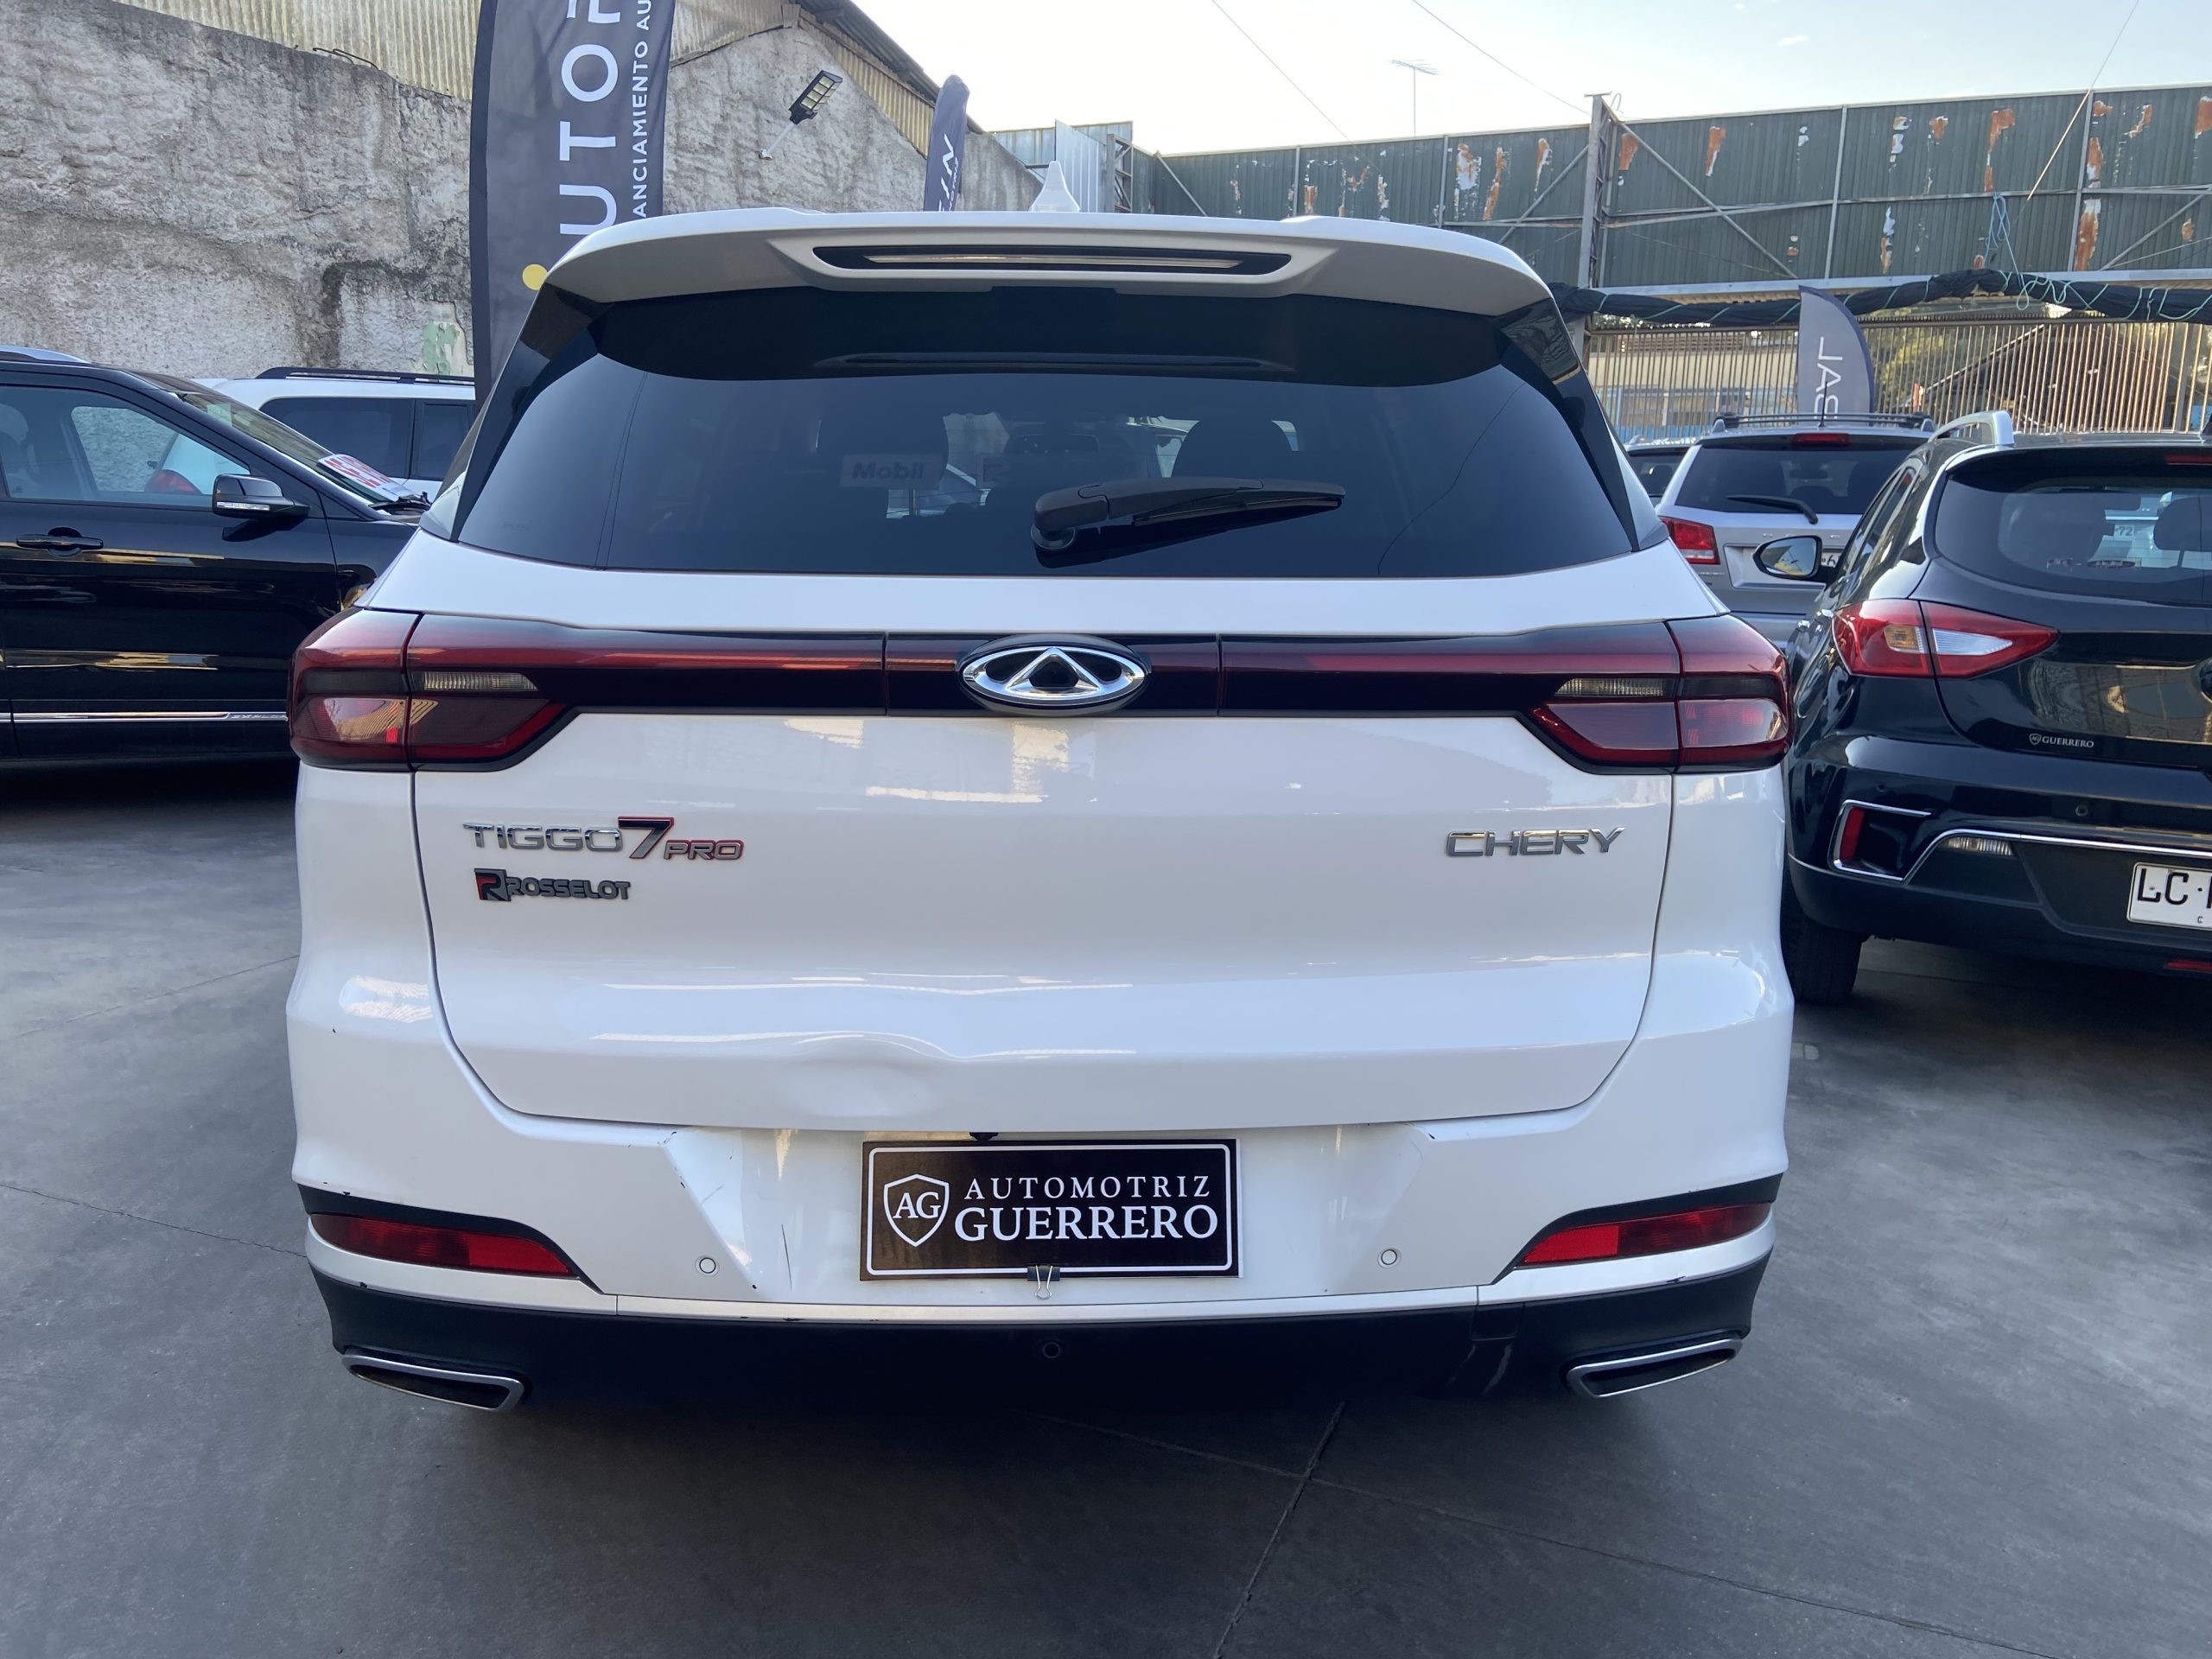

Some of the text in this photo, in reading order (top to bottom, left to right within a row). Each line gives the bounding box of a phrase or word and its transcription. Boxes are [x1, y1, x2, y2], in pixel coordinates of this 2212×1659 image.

[852, 462, 925, 480] Mobil
[2042, 736, 2094, 748] GUERRERO
[1446, 826, 1625, 857] CHERY
[506, 875, 631, 900] ROSSELOT
[963, 1175, 1211, 1200] AUTOMOTRIZ
[893, 1192, 942, 1220] AG
[954, 1204, 1219, 1242] GUERRERO
